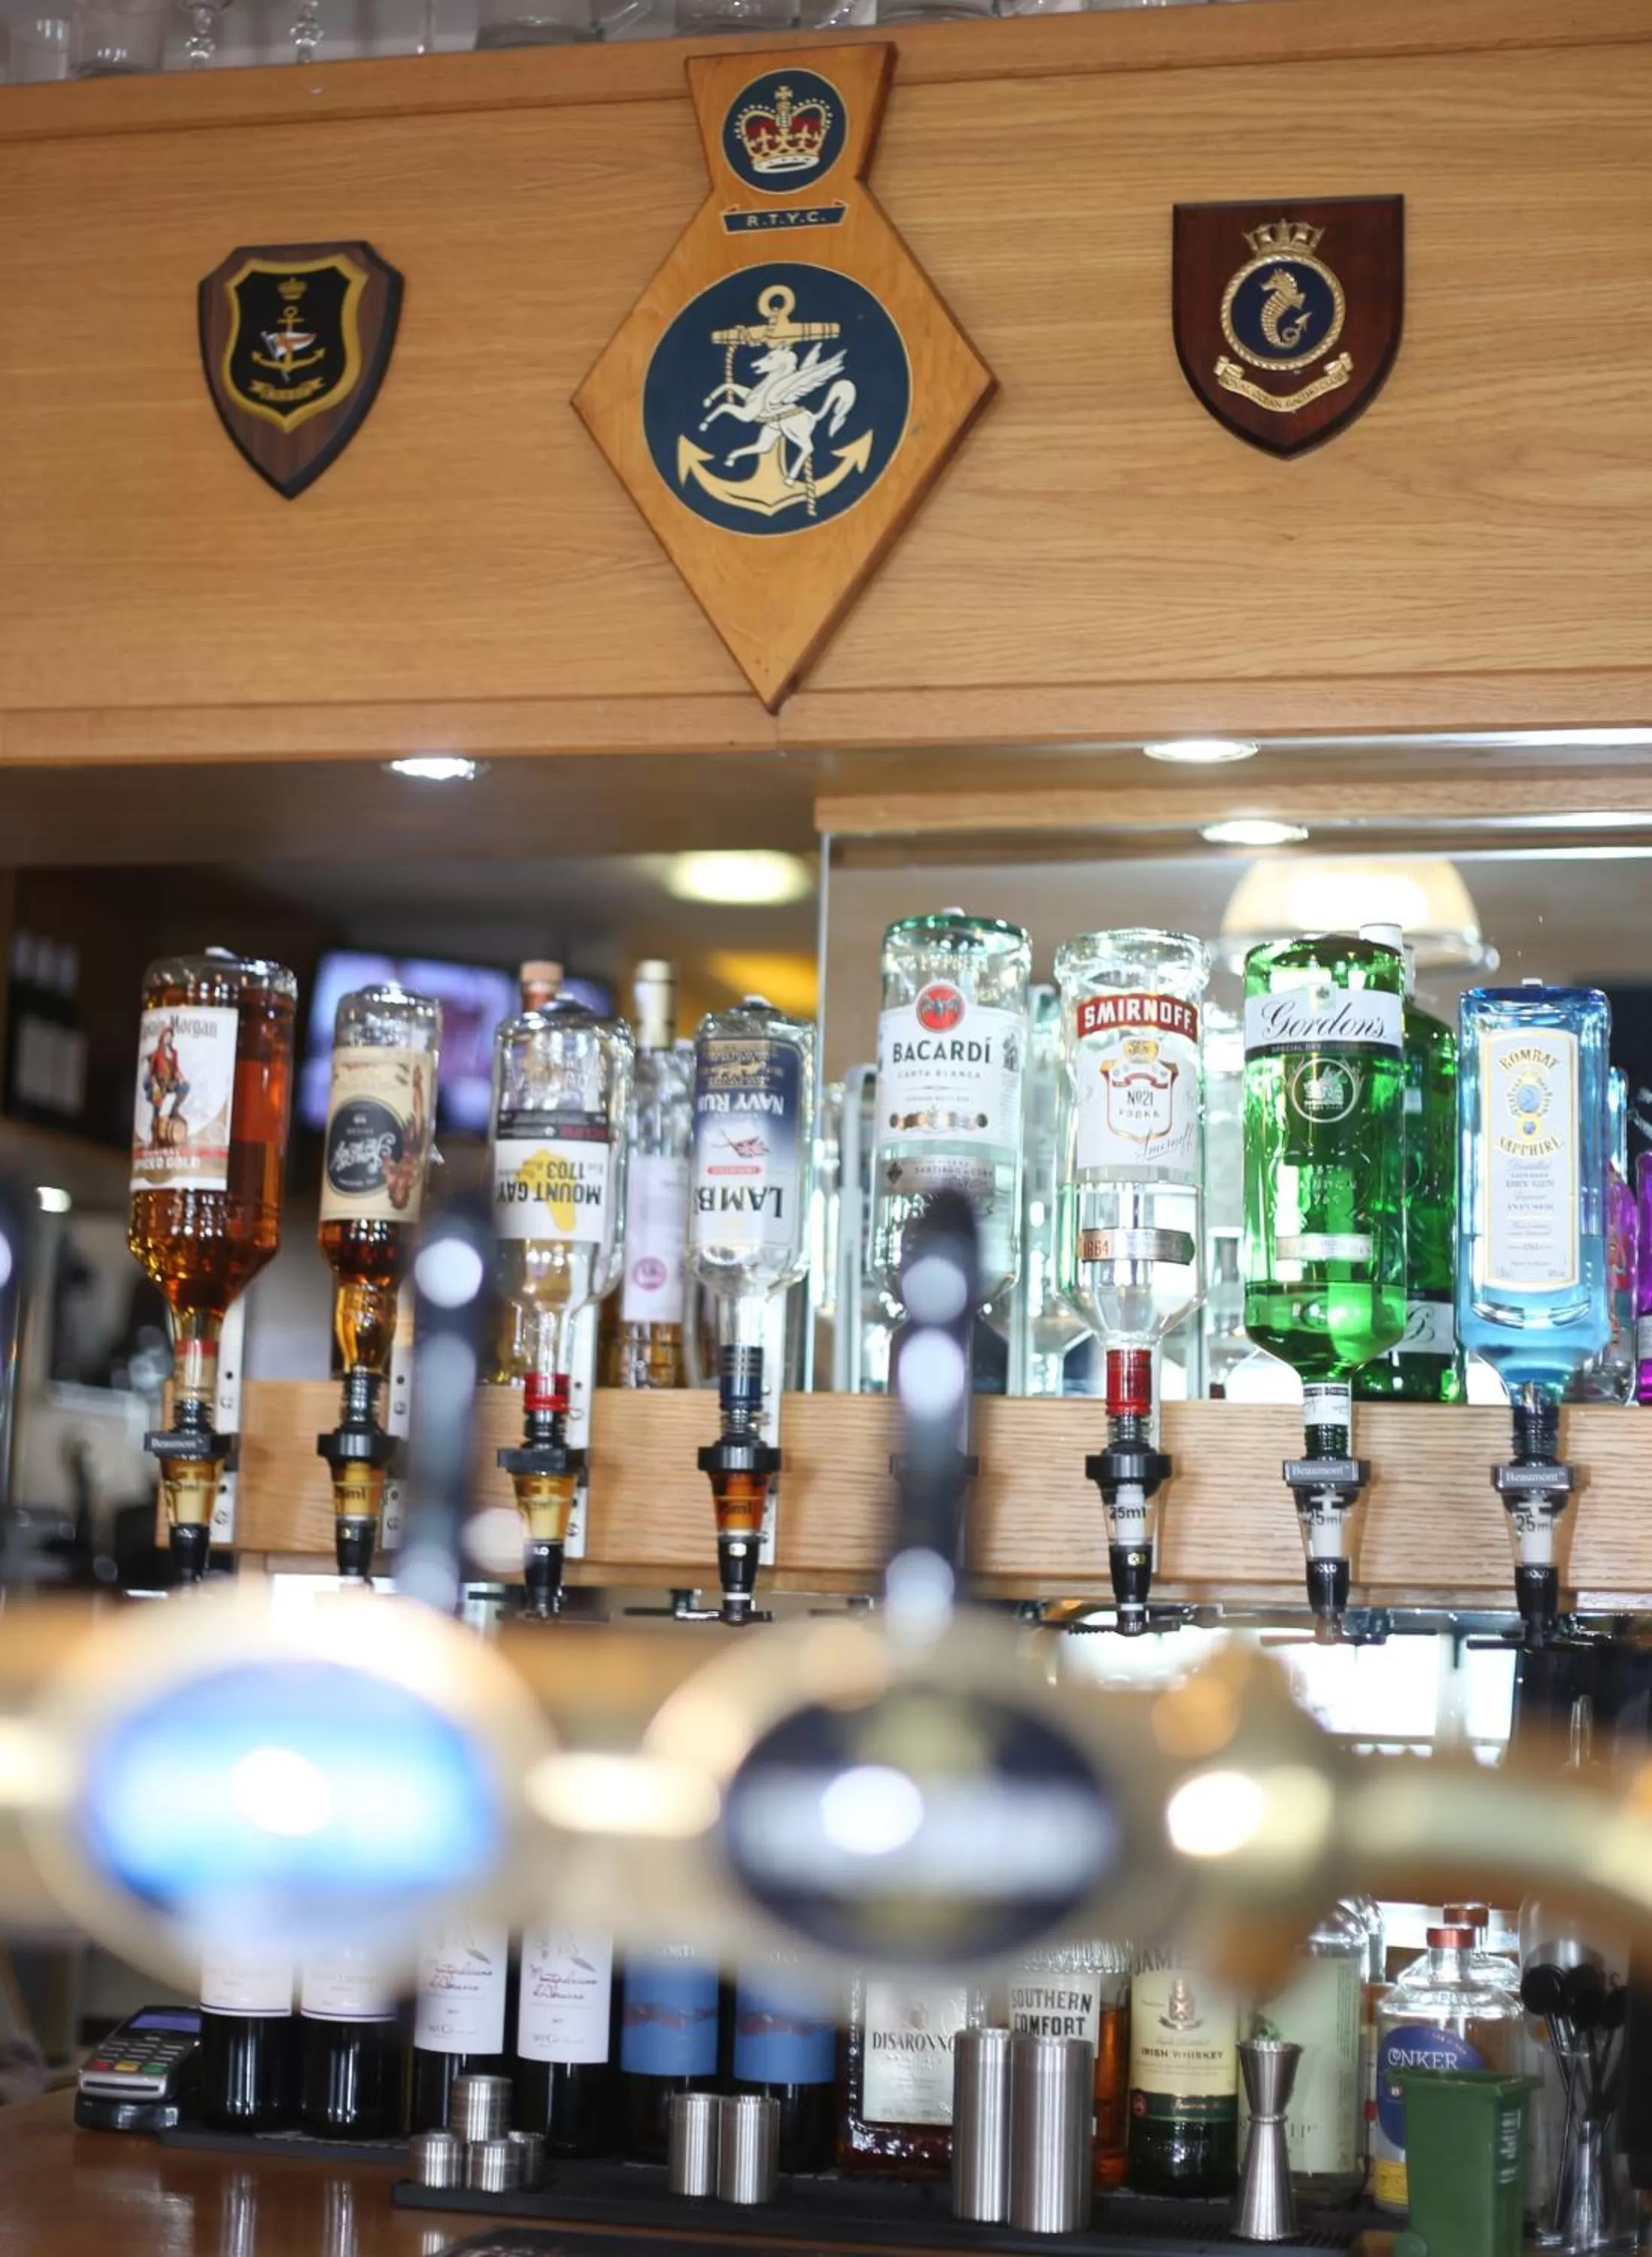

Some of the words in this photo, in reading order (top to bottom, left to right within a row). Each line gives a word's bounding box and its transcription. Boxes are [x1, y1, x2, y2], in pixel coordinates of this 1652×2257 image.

[746, 211, 827, 227] R.T.Y.C.
[1084, 998, 1193, 1031] SMIRNOFF
[1261, 1000, 1386, 1040] Gordon's
[892, 1035, 992, 1064] BACARDÍ
[1499, 1047, 1562, 1071] BOMBAY
[733, 1093, 785, 1116] NAVY
[1499, 1135, 1565, 1157] SAPPHIRE
[546, 1161, 585, 1180] 1703
[495, 1181, 529, 1204] GAY
[533, 1182, 603, 1205] MOUNT
[1505, 1471, 1559, 1482] Beaumont
[1109, 1505, 1147, 1520] 25ml
[1011, 1988, 1093, 2014] SOUTHERN
[1014, 2012, 1086, 2037] COMFORT
[872, 2031, 955, 2054] DISARONNO
[1140, 2046, 1169, 2059] IRISH
[1172, 2048, 1225, 2061] WHISKEY
